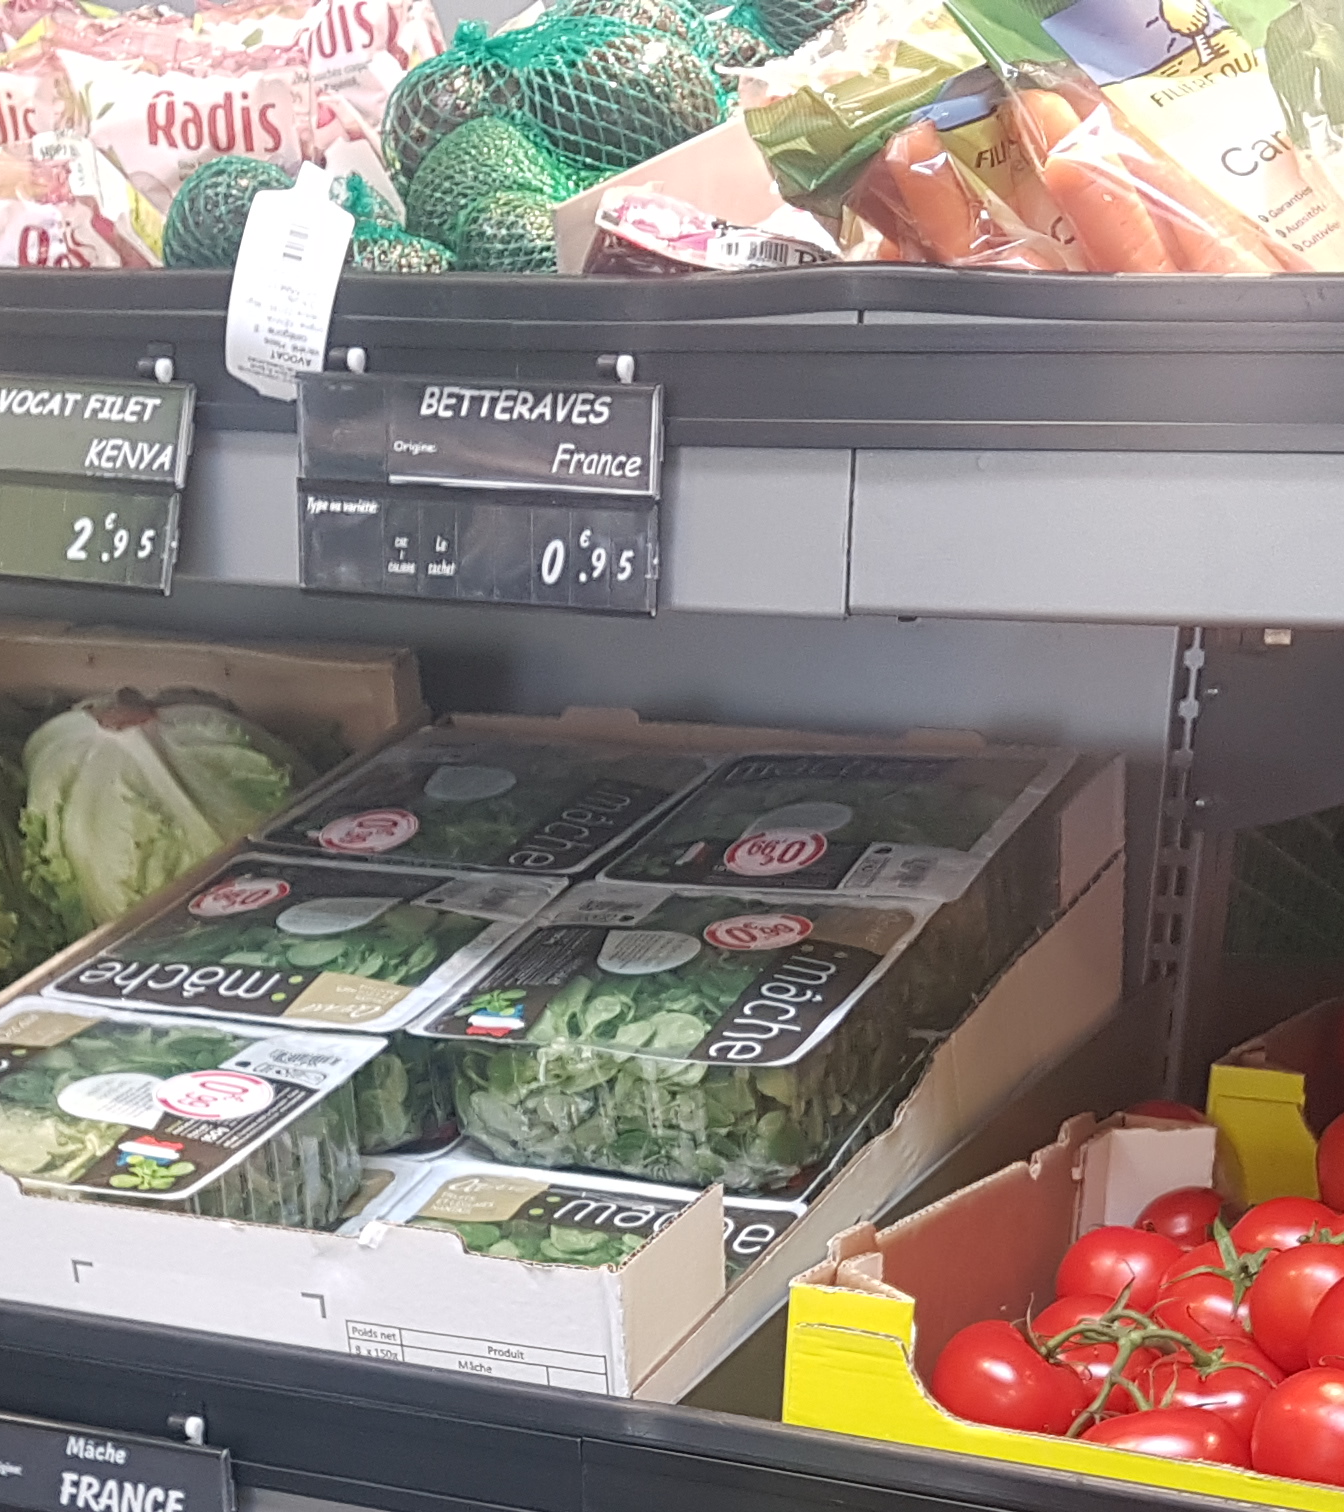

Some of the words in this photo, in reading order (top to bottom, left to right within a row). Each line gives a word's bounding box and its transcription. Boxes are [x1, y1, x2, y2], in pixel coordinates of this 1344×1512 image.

[146, 90, 283, 152] Radis
[83, 394, 163, 424] FILET
[418, 385, 612, 425] BETTERAVES
[83, 438, 175, 471] KENYA
[550, 442, 643, 478] France
[78, 959, 282, 1000] mâche
[707, 953, 839, 1061] mâche
[351, 1326, 378, 1341] Poids
[379, 1329, 398, 1343] net
[457, 1359, 493, 1374] Mâche
[487, 1344, 526, 1361] Produit
[65, 1435, 128, 1466] Mâche
